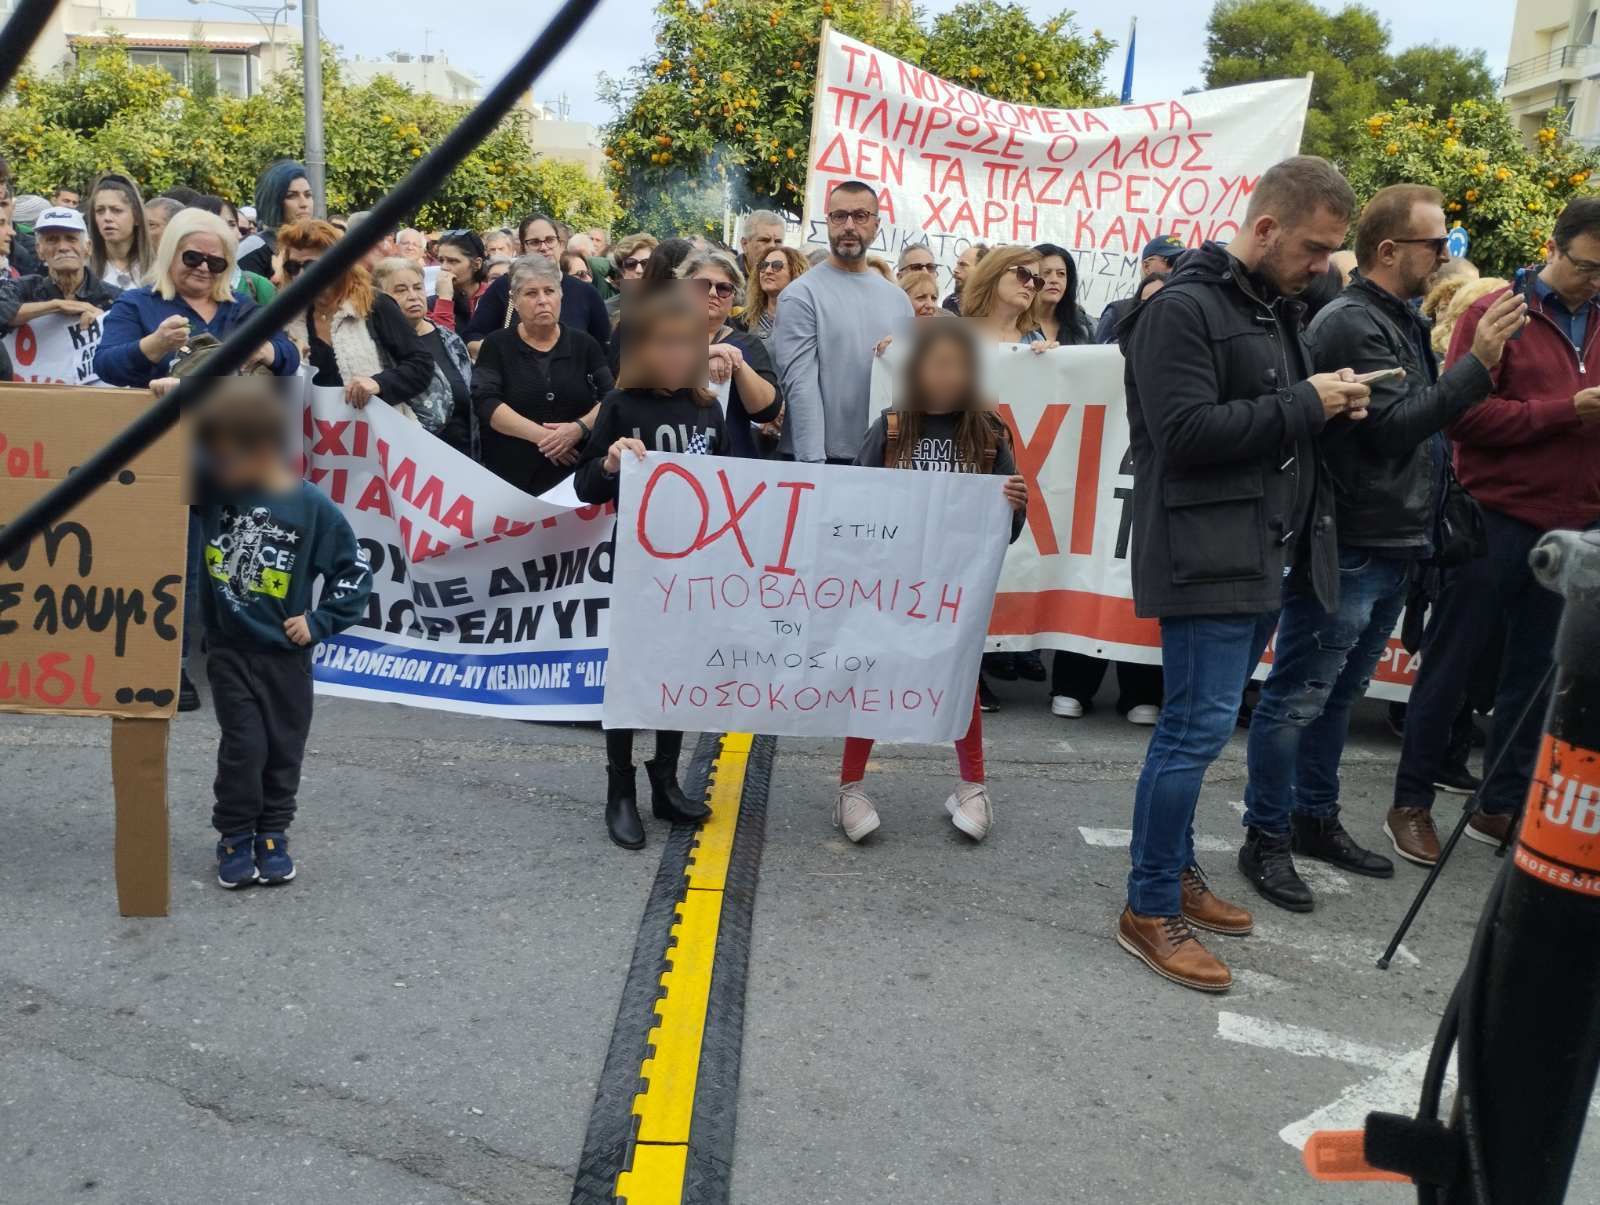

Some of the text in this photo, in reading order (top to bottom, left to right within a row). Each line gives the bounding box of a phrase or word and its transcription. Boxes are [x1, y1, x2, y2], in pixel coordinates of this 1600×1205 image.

[840, 44, 1194, 134] ΤΑ ΝΟΣΟΚΟΜΕΙΑ ΤΑ
[826, 86, 1214, 171] ΠΛΗΡΩΣΕ Ο ΛΑΟΣ
[815, 133, 905, 183] ΔΕΝ
[920, 152, 969, 198] ΤΑ
[922, 194, 1038, 242] ΧΑΡΗ
[637, 462, 816, 577] ΟΧΙ
[831, 522, 900, 541] ΣΤΗΝ
[653, 573, 963, 624] ΥΠΟΒΑΘΜΙΣΗ
[487, 662, 572, 691] ΝΕΑΠΟΛΗΣ
[705, 647, 879, 674] ΔΗΜΟΣΙΟΥ
[660, 680, 945, 716] ΝΟΣΟΚΟΜΕΙΟΥ
